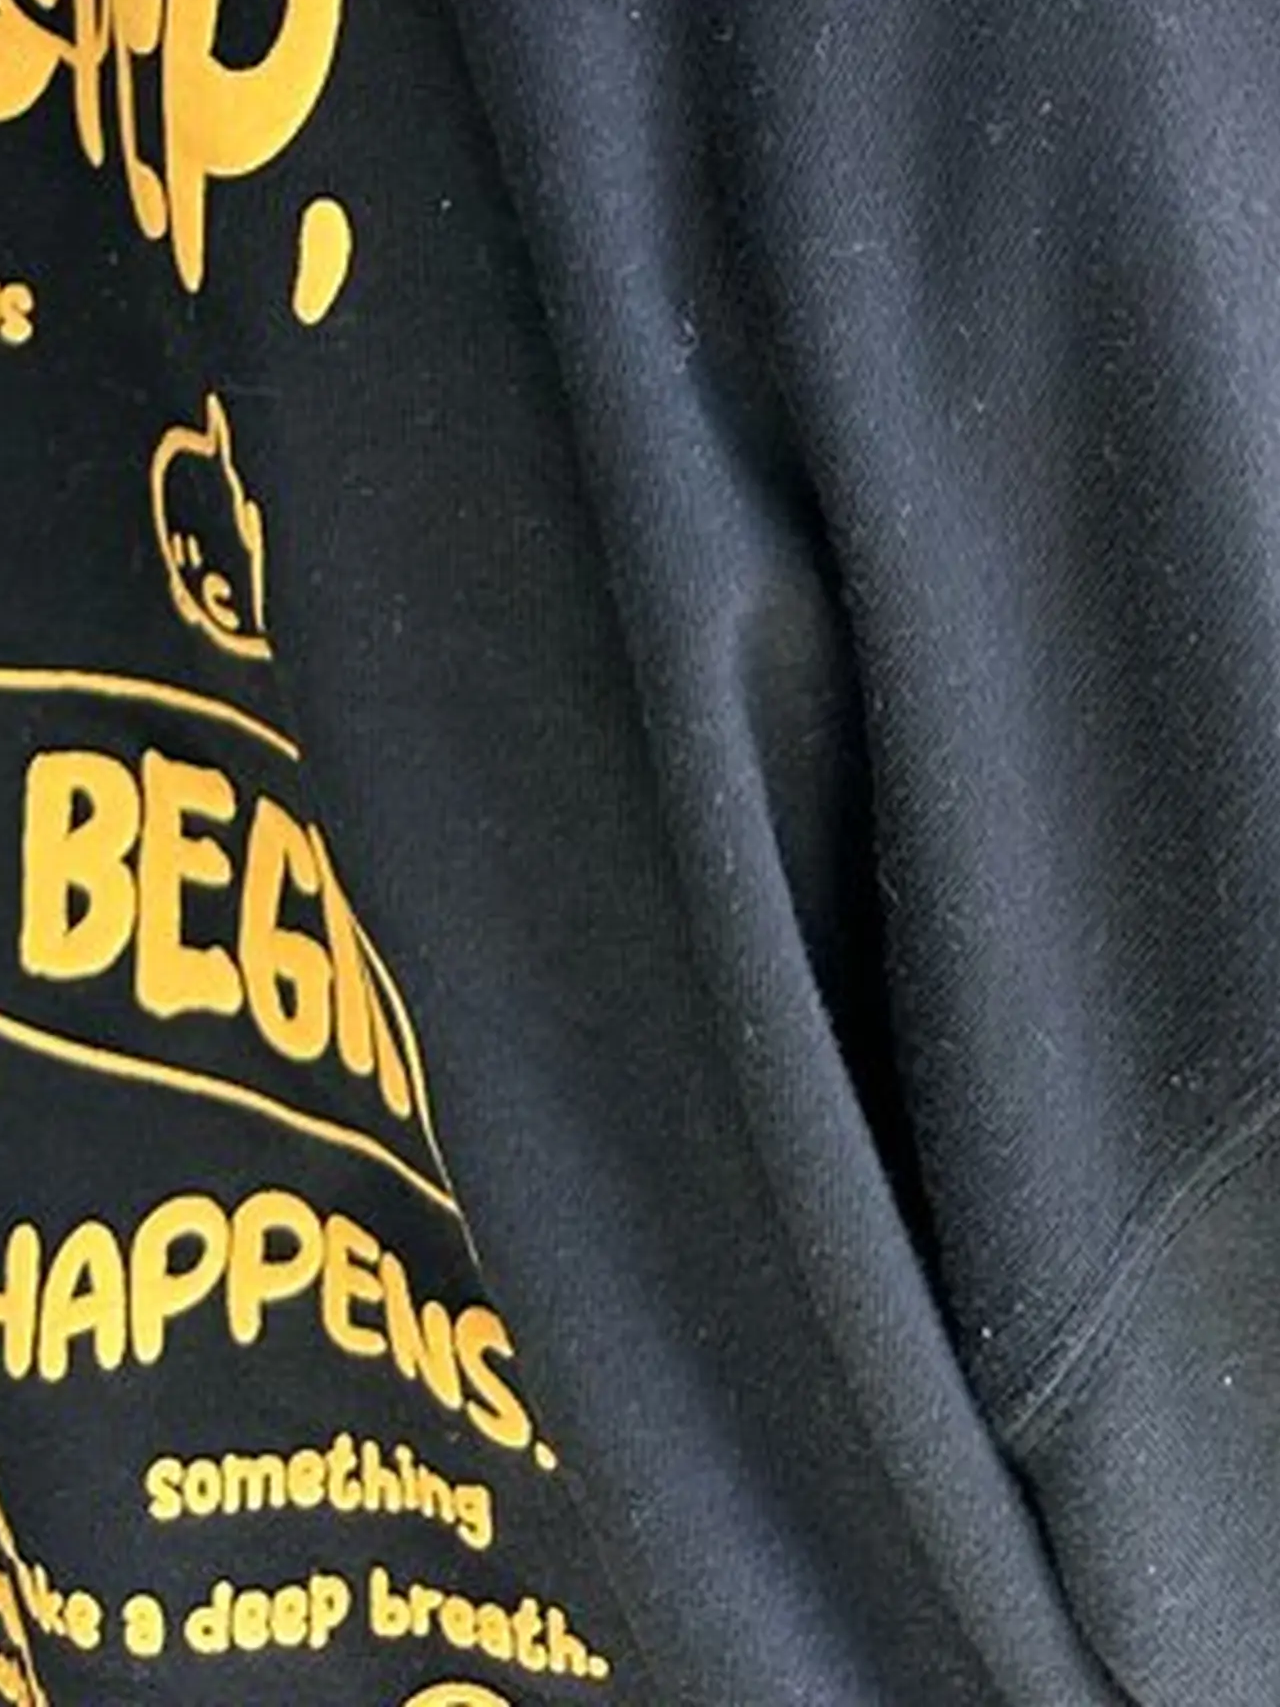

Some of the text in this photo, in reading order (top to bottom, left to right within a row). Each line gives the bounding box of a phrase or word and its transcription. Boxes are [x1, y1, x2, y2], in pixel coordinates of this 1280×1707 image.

[145, 1433, 492, 1550] something
[124, 1595, 165, 1657] a
[183, 1580, 351, 1653] deep
[370, 1566, 609, 1679] breath.
